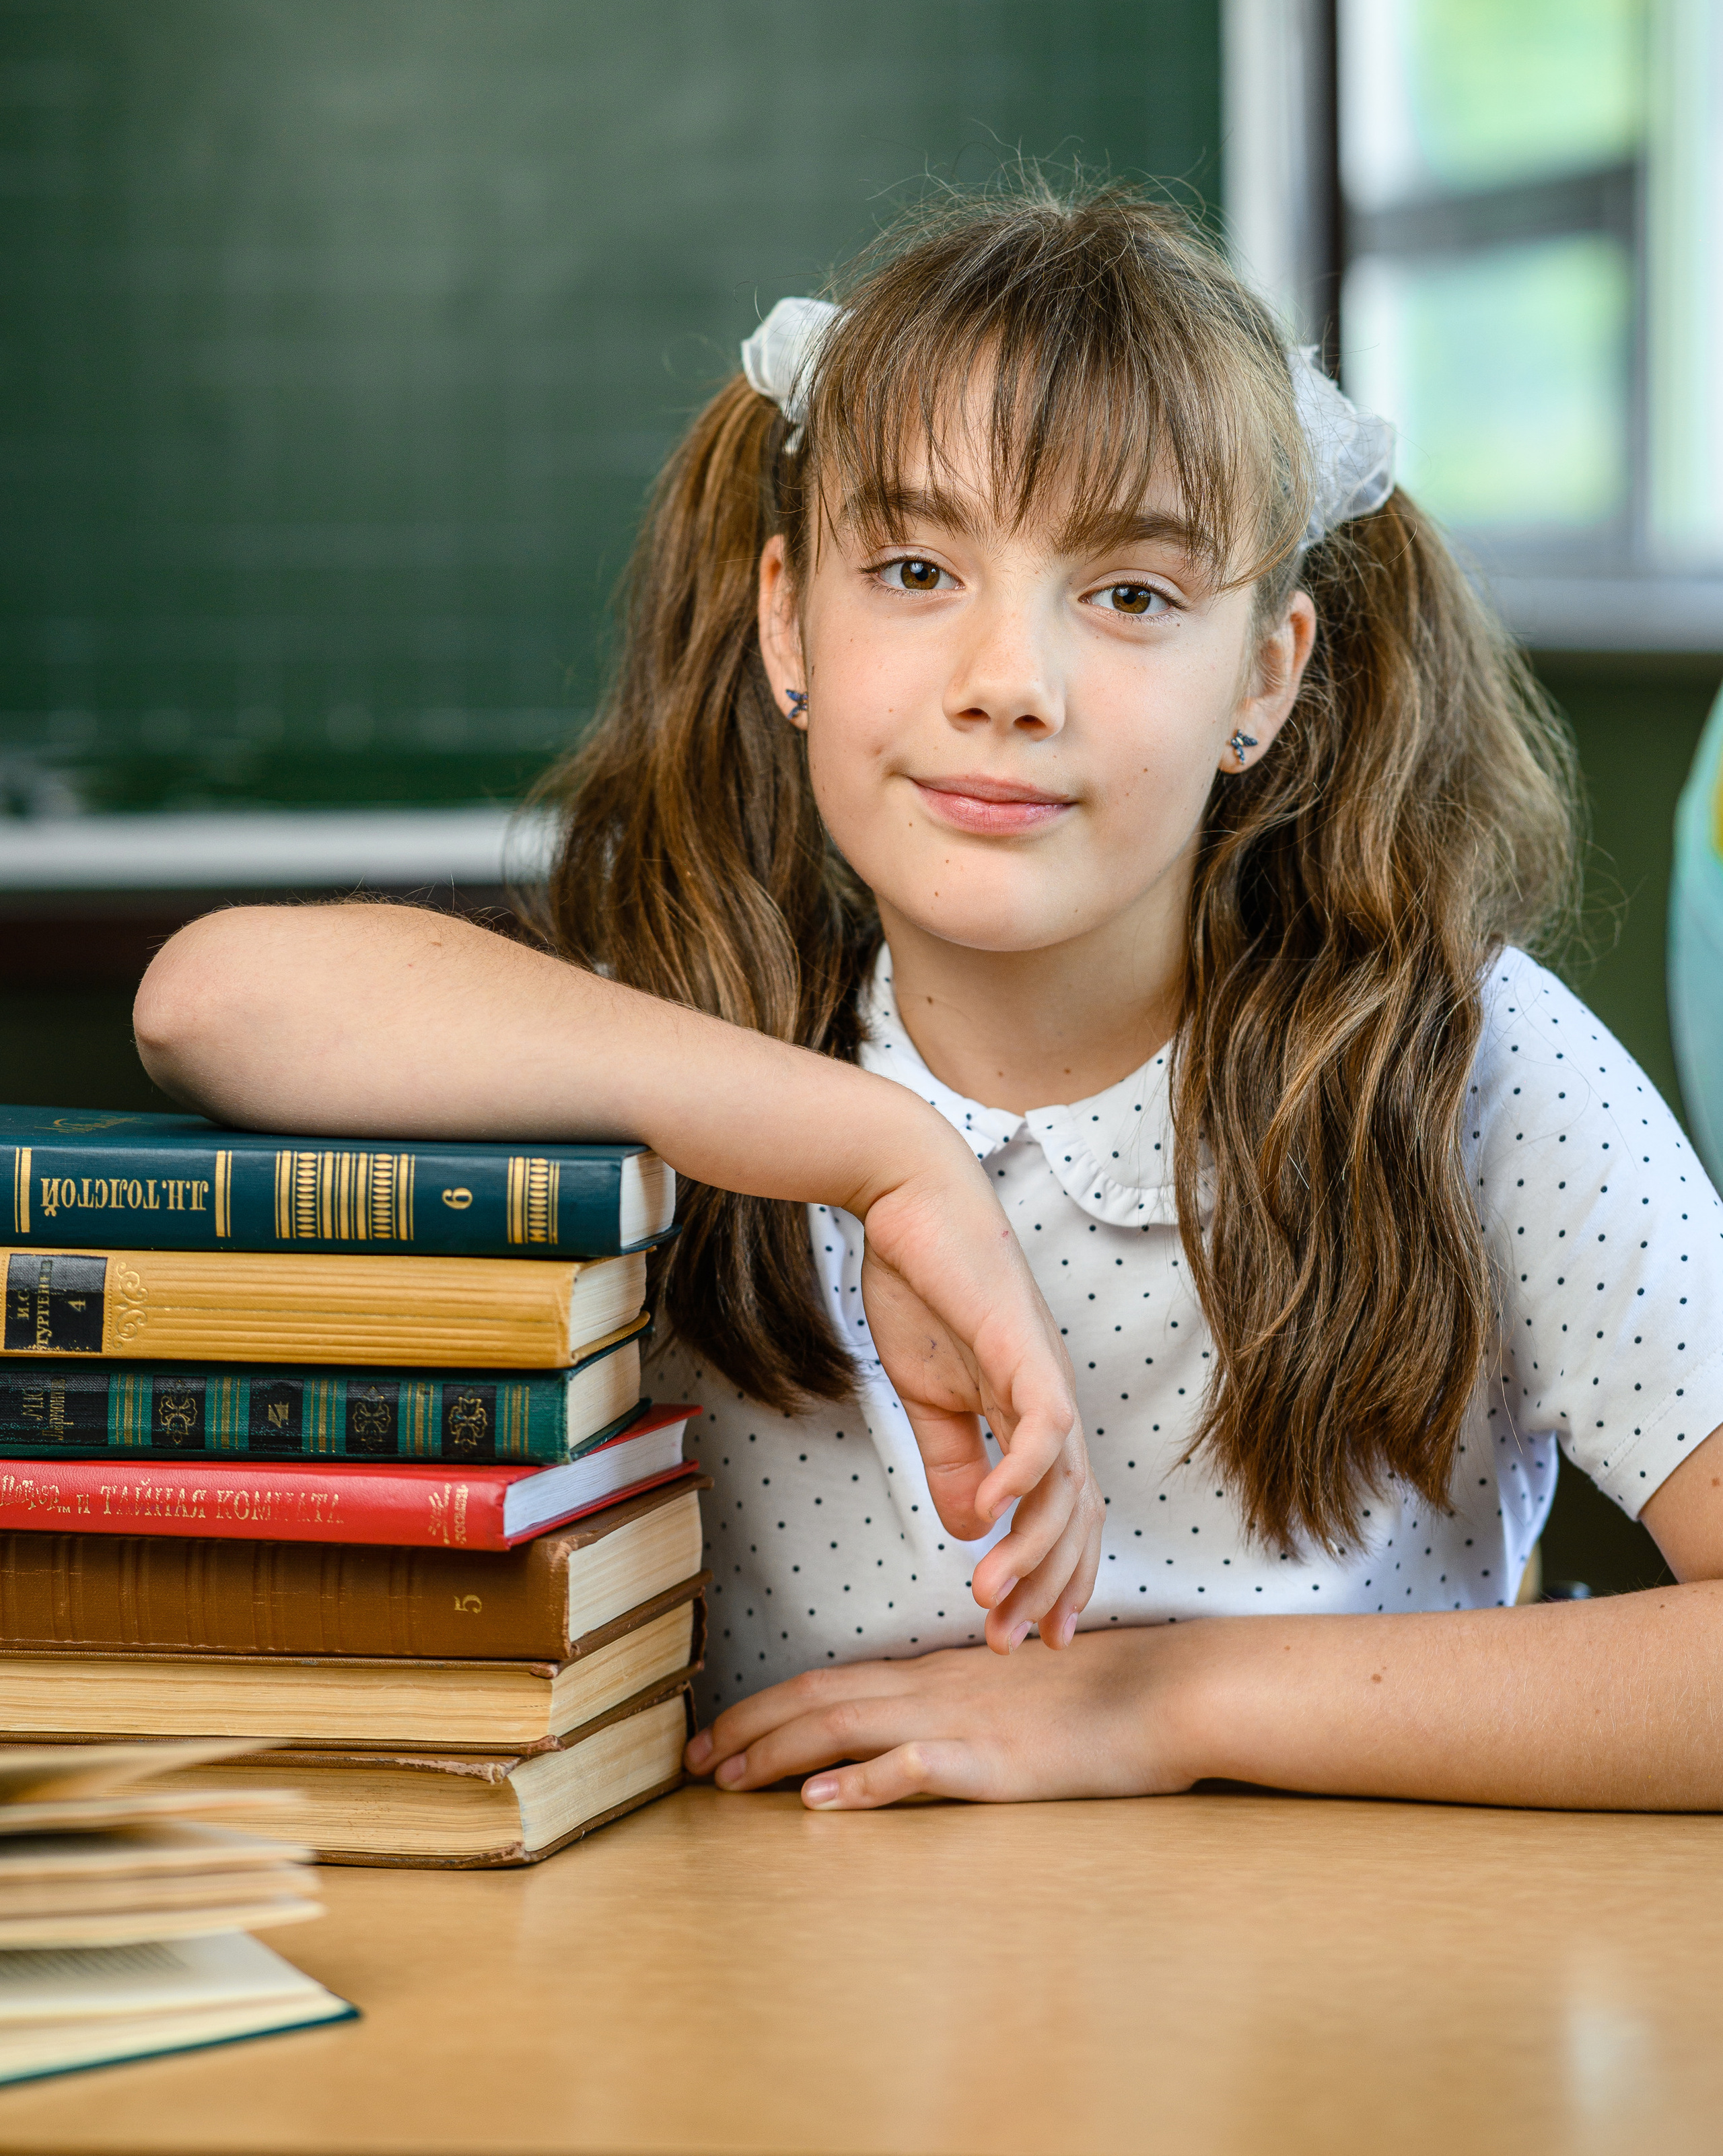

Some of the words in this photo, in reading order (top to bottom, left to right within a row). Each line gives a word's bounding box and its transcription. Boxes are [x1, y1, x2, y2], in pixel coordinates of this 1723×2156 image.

[40, 1178, 209, 1217] Л.Н.ТОЛСТОЙ
[442, 1187, 473, 1210] 6
[67, 1298, 86, 1313] 4
[453, 1595, 482, 1614] 5
